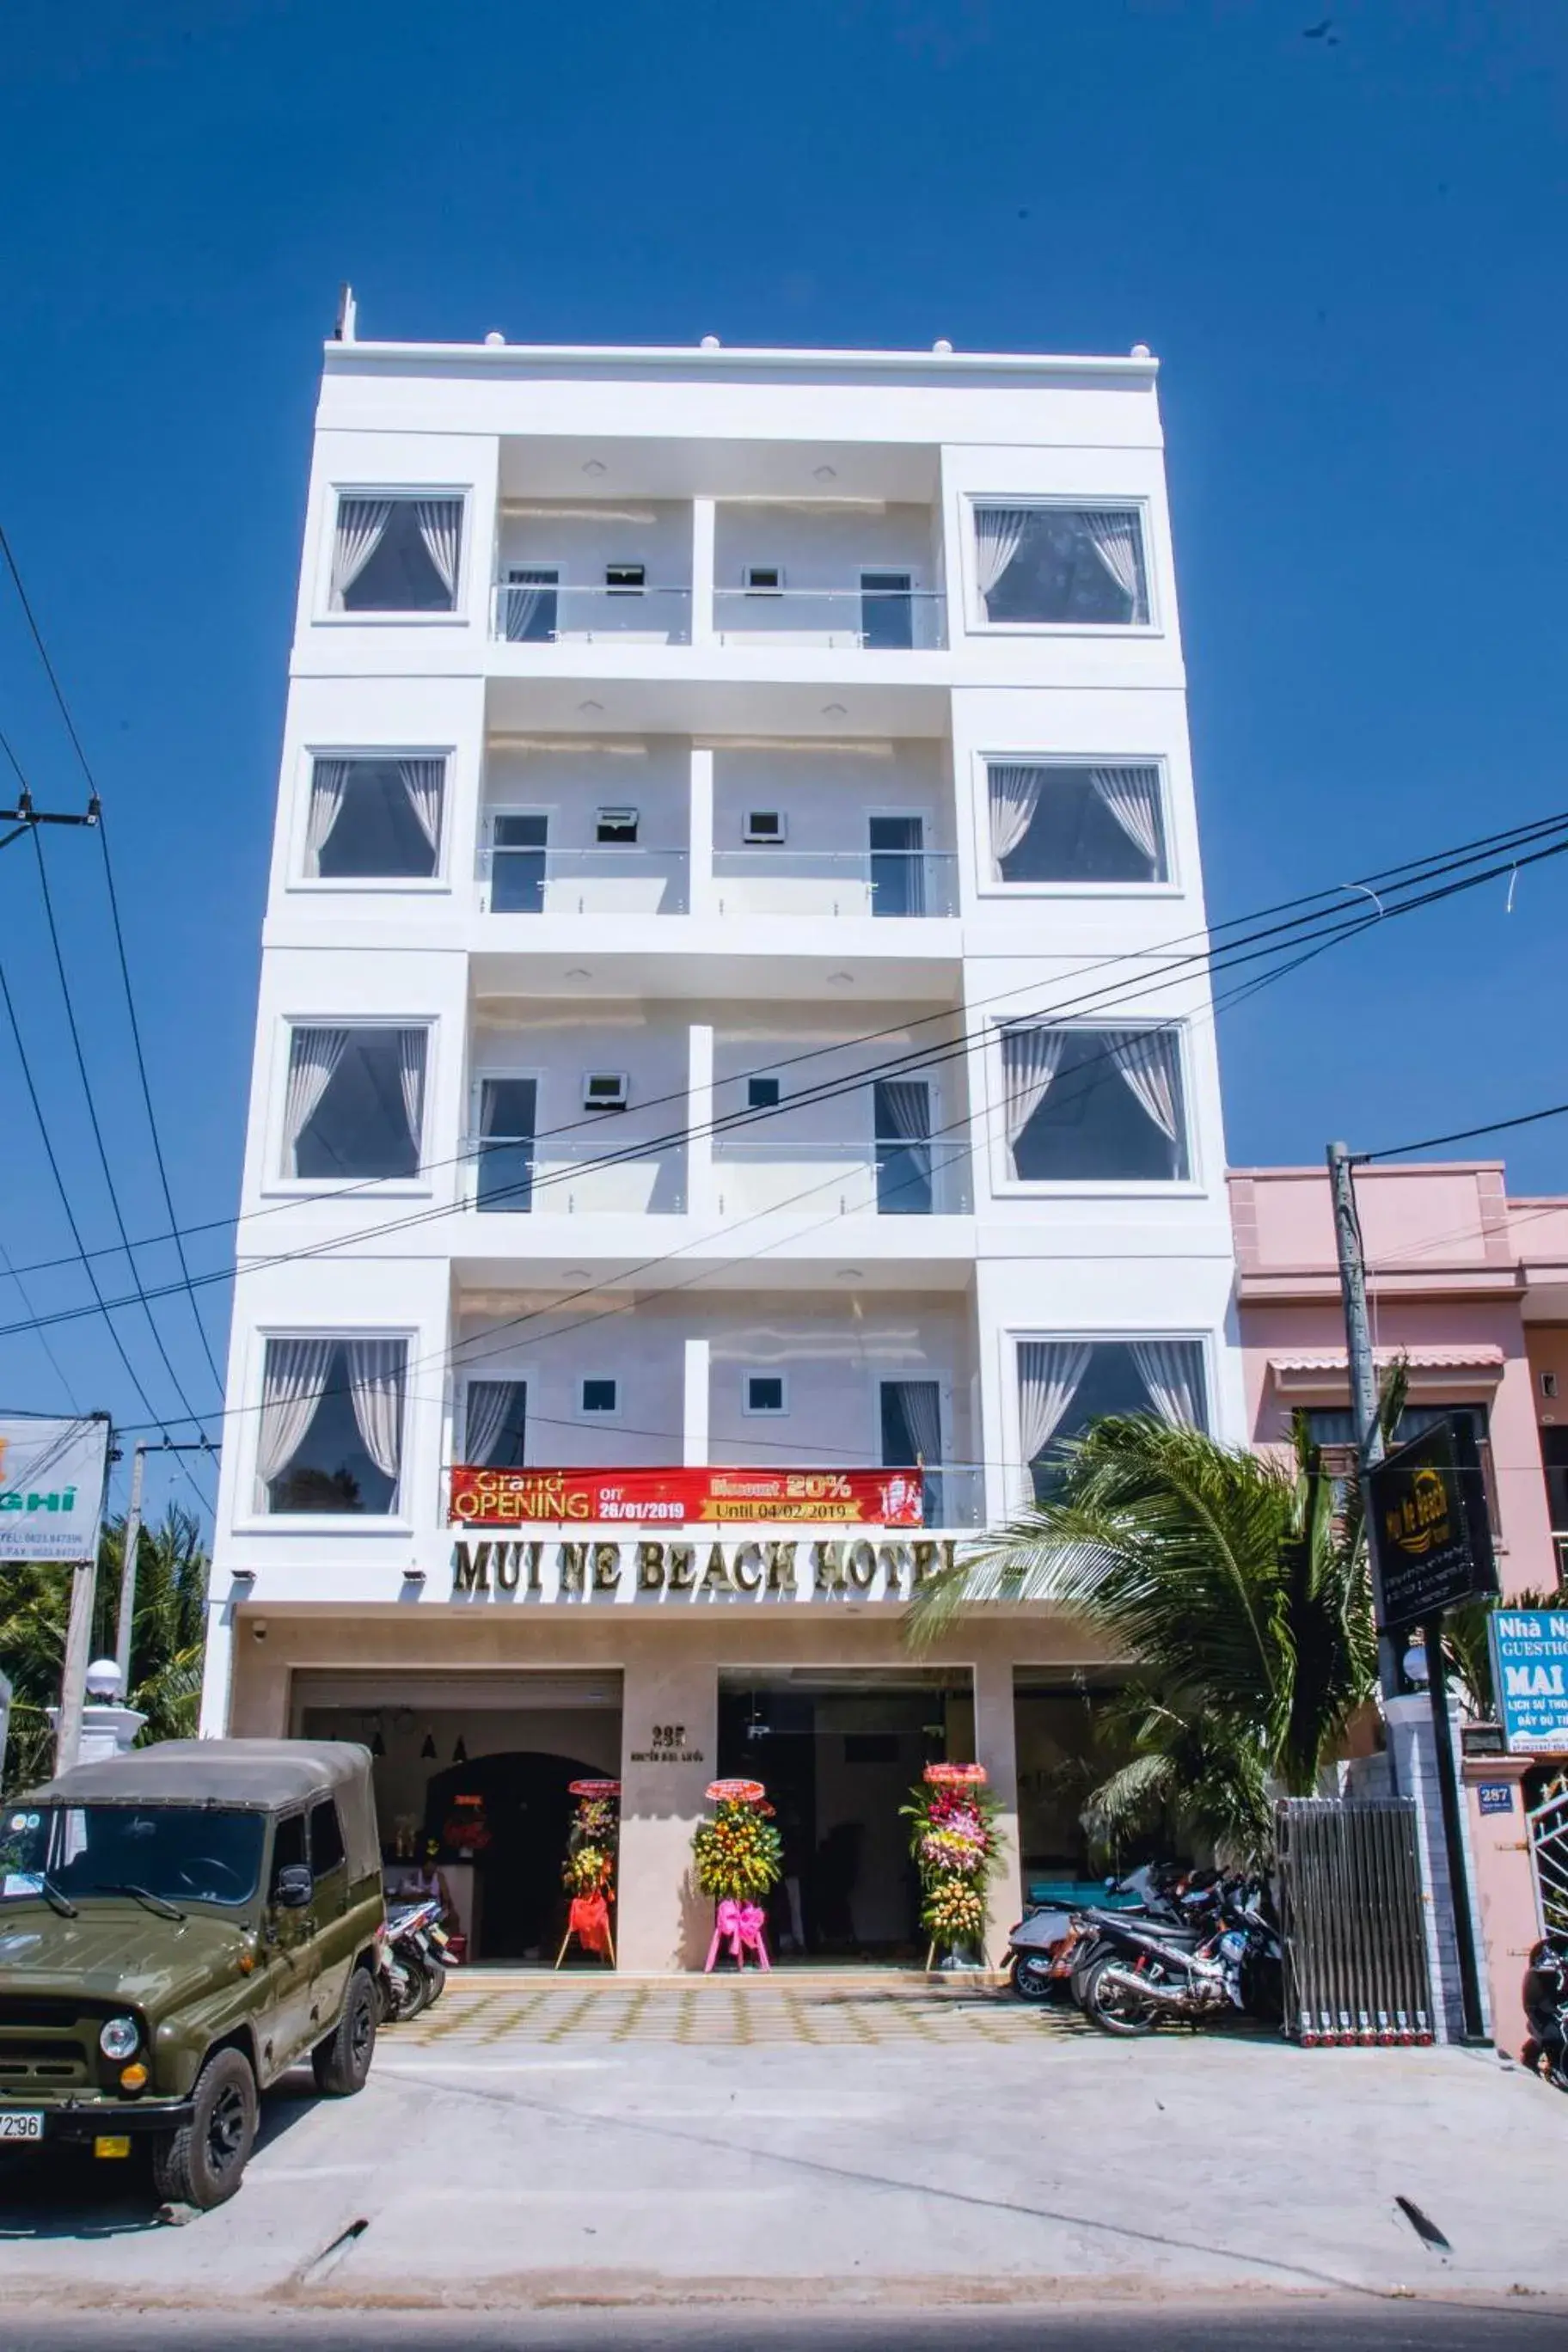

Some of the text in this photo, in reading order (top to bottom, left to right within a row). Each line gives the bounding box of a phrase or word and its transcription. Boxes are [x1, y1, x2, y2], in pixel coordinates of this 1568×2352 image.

[475, 1471, 566, 1492] Grand
[787, 1474, 851, 1498] 20%
[455, 1492, 590, 1519] OPENING
[600, 1488, 622, 1501] on
[716, 1504, 753, 1519] Until
[453, 1540, 544, 1590] MUI
[560, 1540, 622, 1590] NE
[638, 1539, 798, 1591] BEACH
[1499, 1616, 1568, 1639] Nhà N
[1504, 1664, 1565, 1696] MAI
[1481, 1788, 1508, 1803] 287
